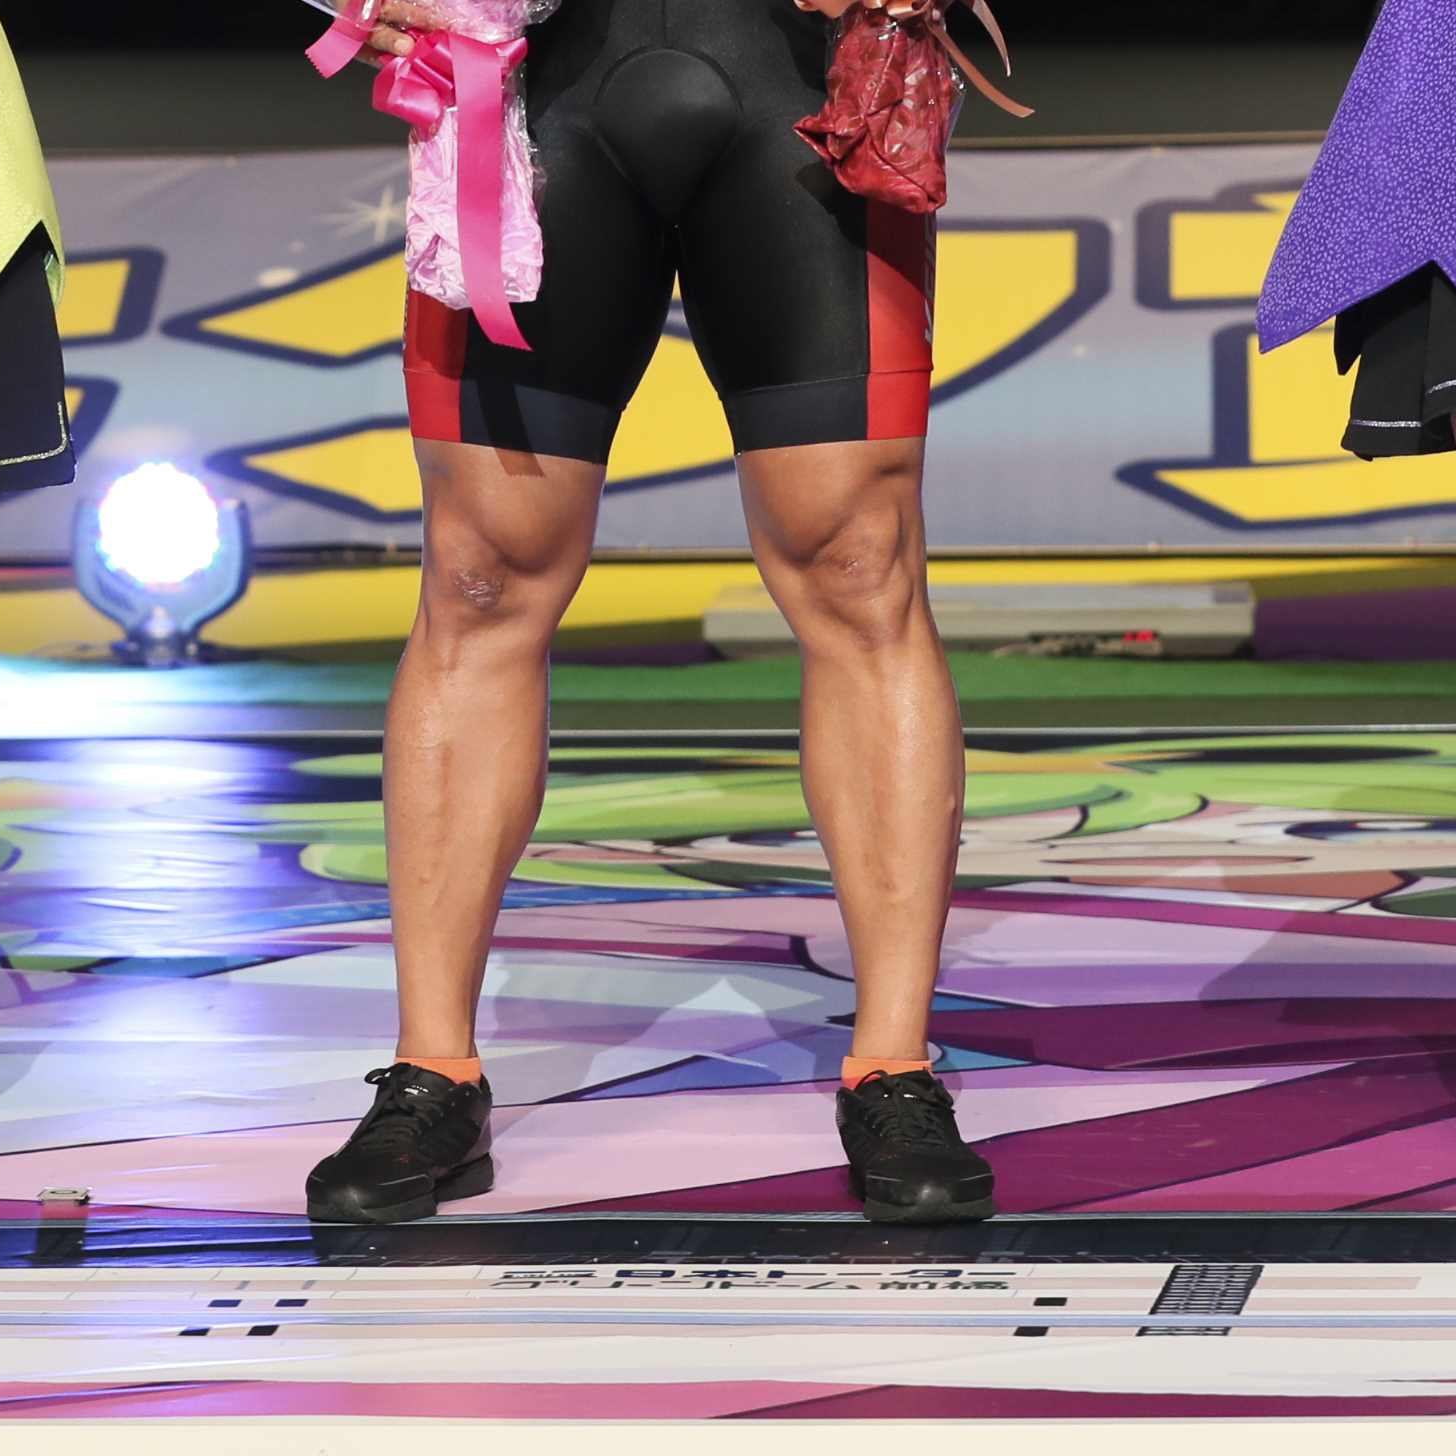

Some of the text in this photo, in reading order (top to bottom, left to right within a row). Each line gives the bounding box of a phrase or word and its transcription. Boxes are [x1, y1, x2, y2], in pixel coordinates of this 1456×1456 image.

[615, 1268, 1018, 1279] 日本トーター
